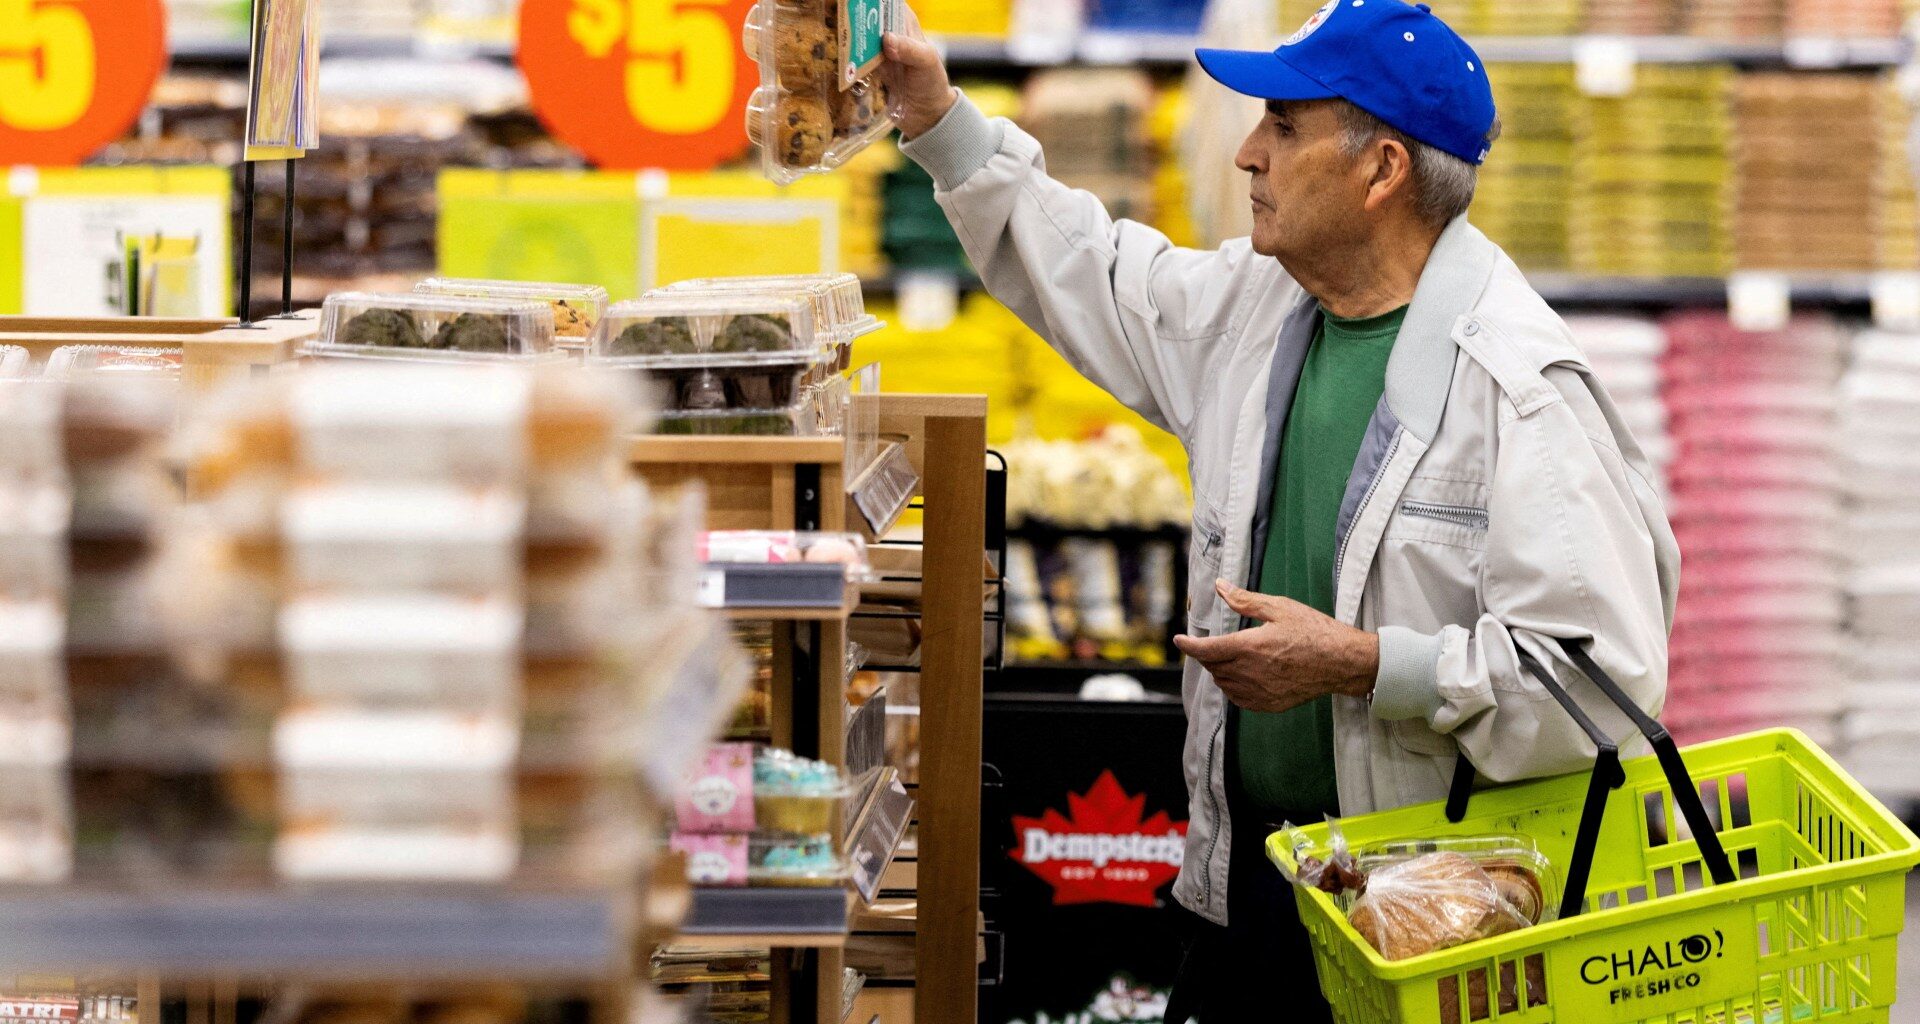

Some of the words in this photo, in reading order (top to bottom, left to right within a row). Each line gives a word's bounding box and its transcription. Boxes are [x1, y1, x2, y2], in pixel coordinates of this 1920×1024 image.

[0, 0, 96, 131] 5
[1024, 828, 1187, 868] Dempster's
[1580, 927, 1724, 985] CHALO!
